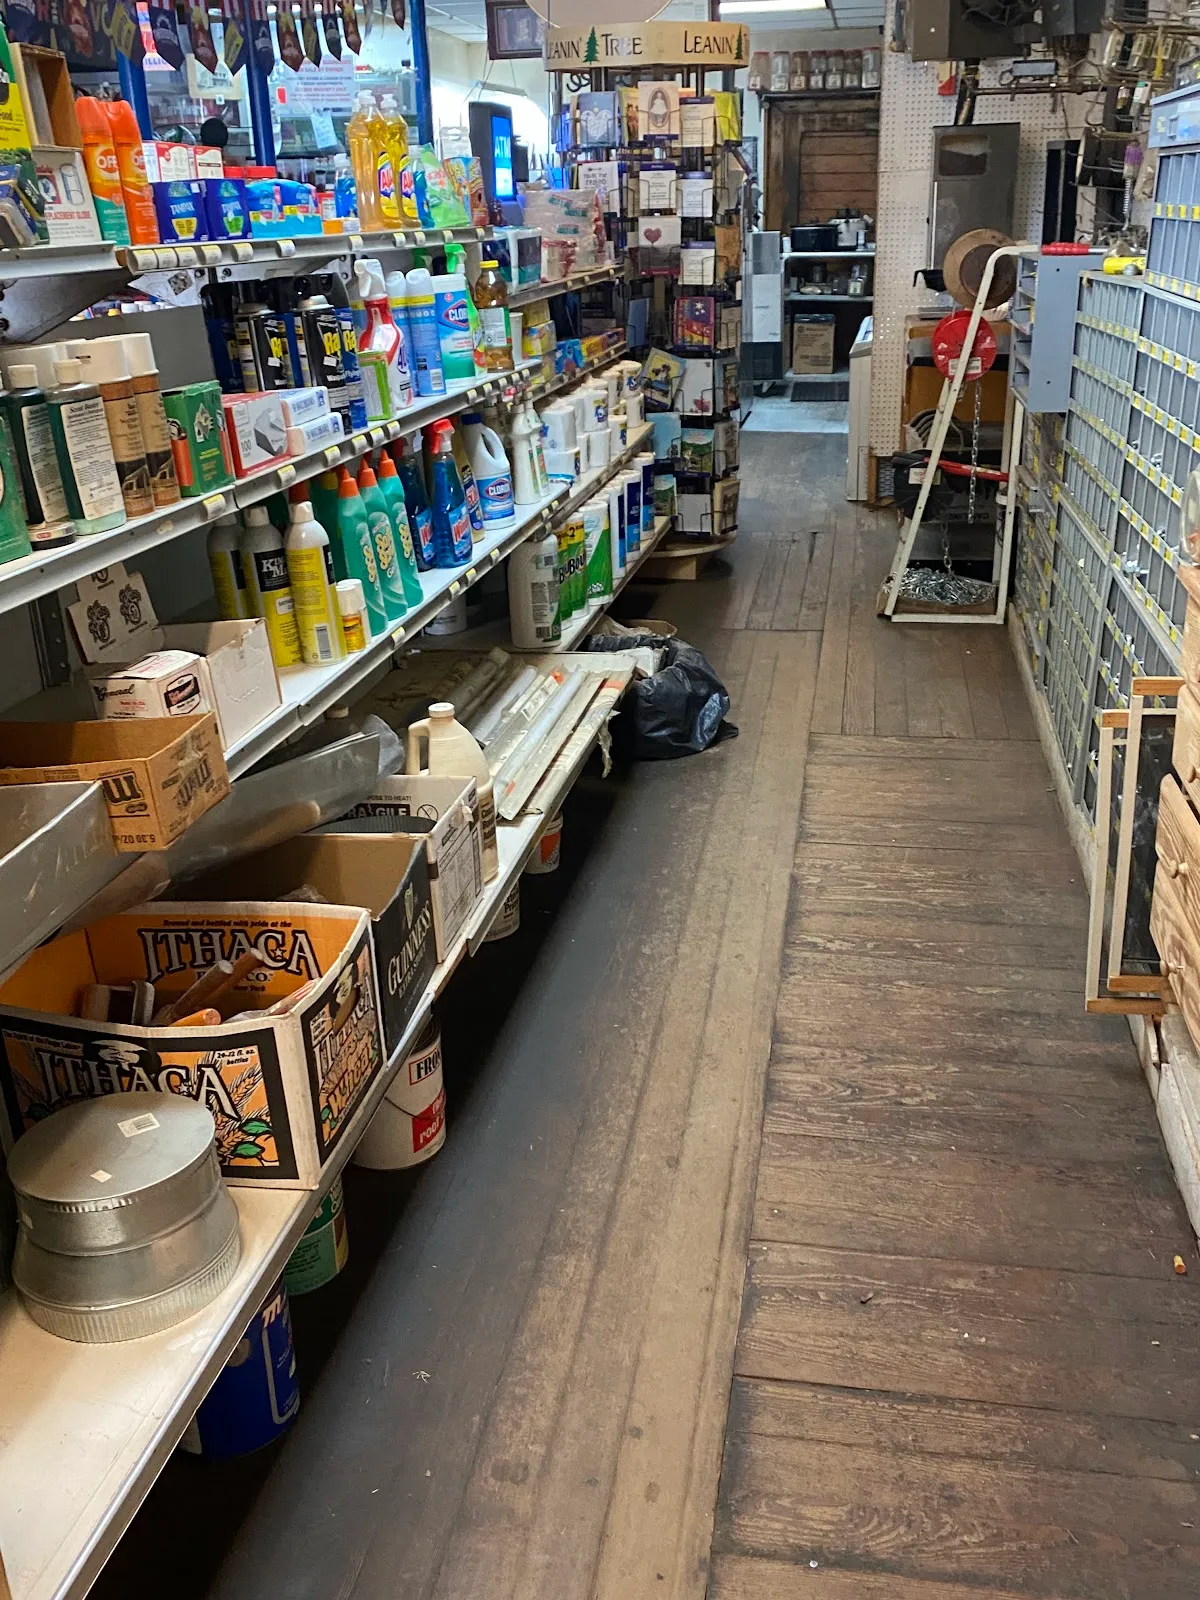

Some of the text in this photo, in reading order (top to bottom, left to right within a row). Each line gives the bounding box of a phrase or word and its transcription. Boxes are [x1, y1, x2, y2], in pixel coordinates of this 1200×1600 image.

[601, 33, 643, 57] TREE
[684, 30, 735, 55] LEANIN'
[495, 136, 511, 158] ATM
[170, 201, 194, 215] TAMPAX
[347, 805, 407, 818] RAGILE
[250, 920, 268, 929] pride
[280, 920, 292, 928] the
[138, 929, 322, 984] ITHACA
[35, 1050, 241, 1121] ITHACA
